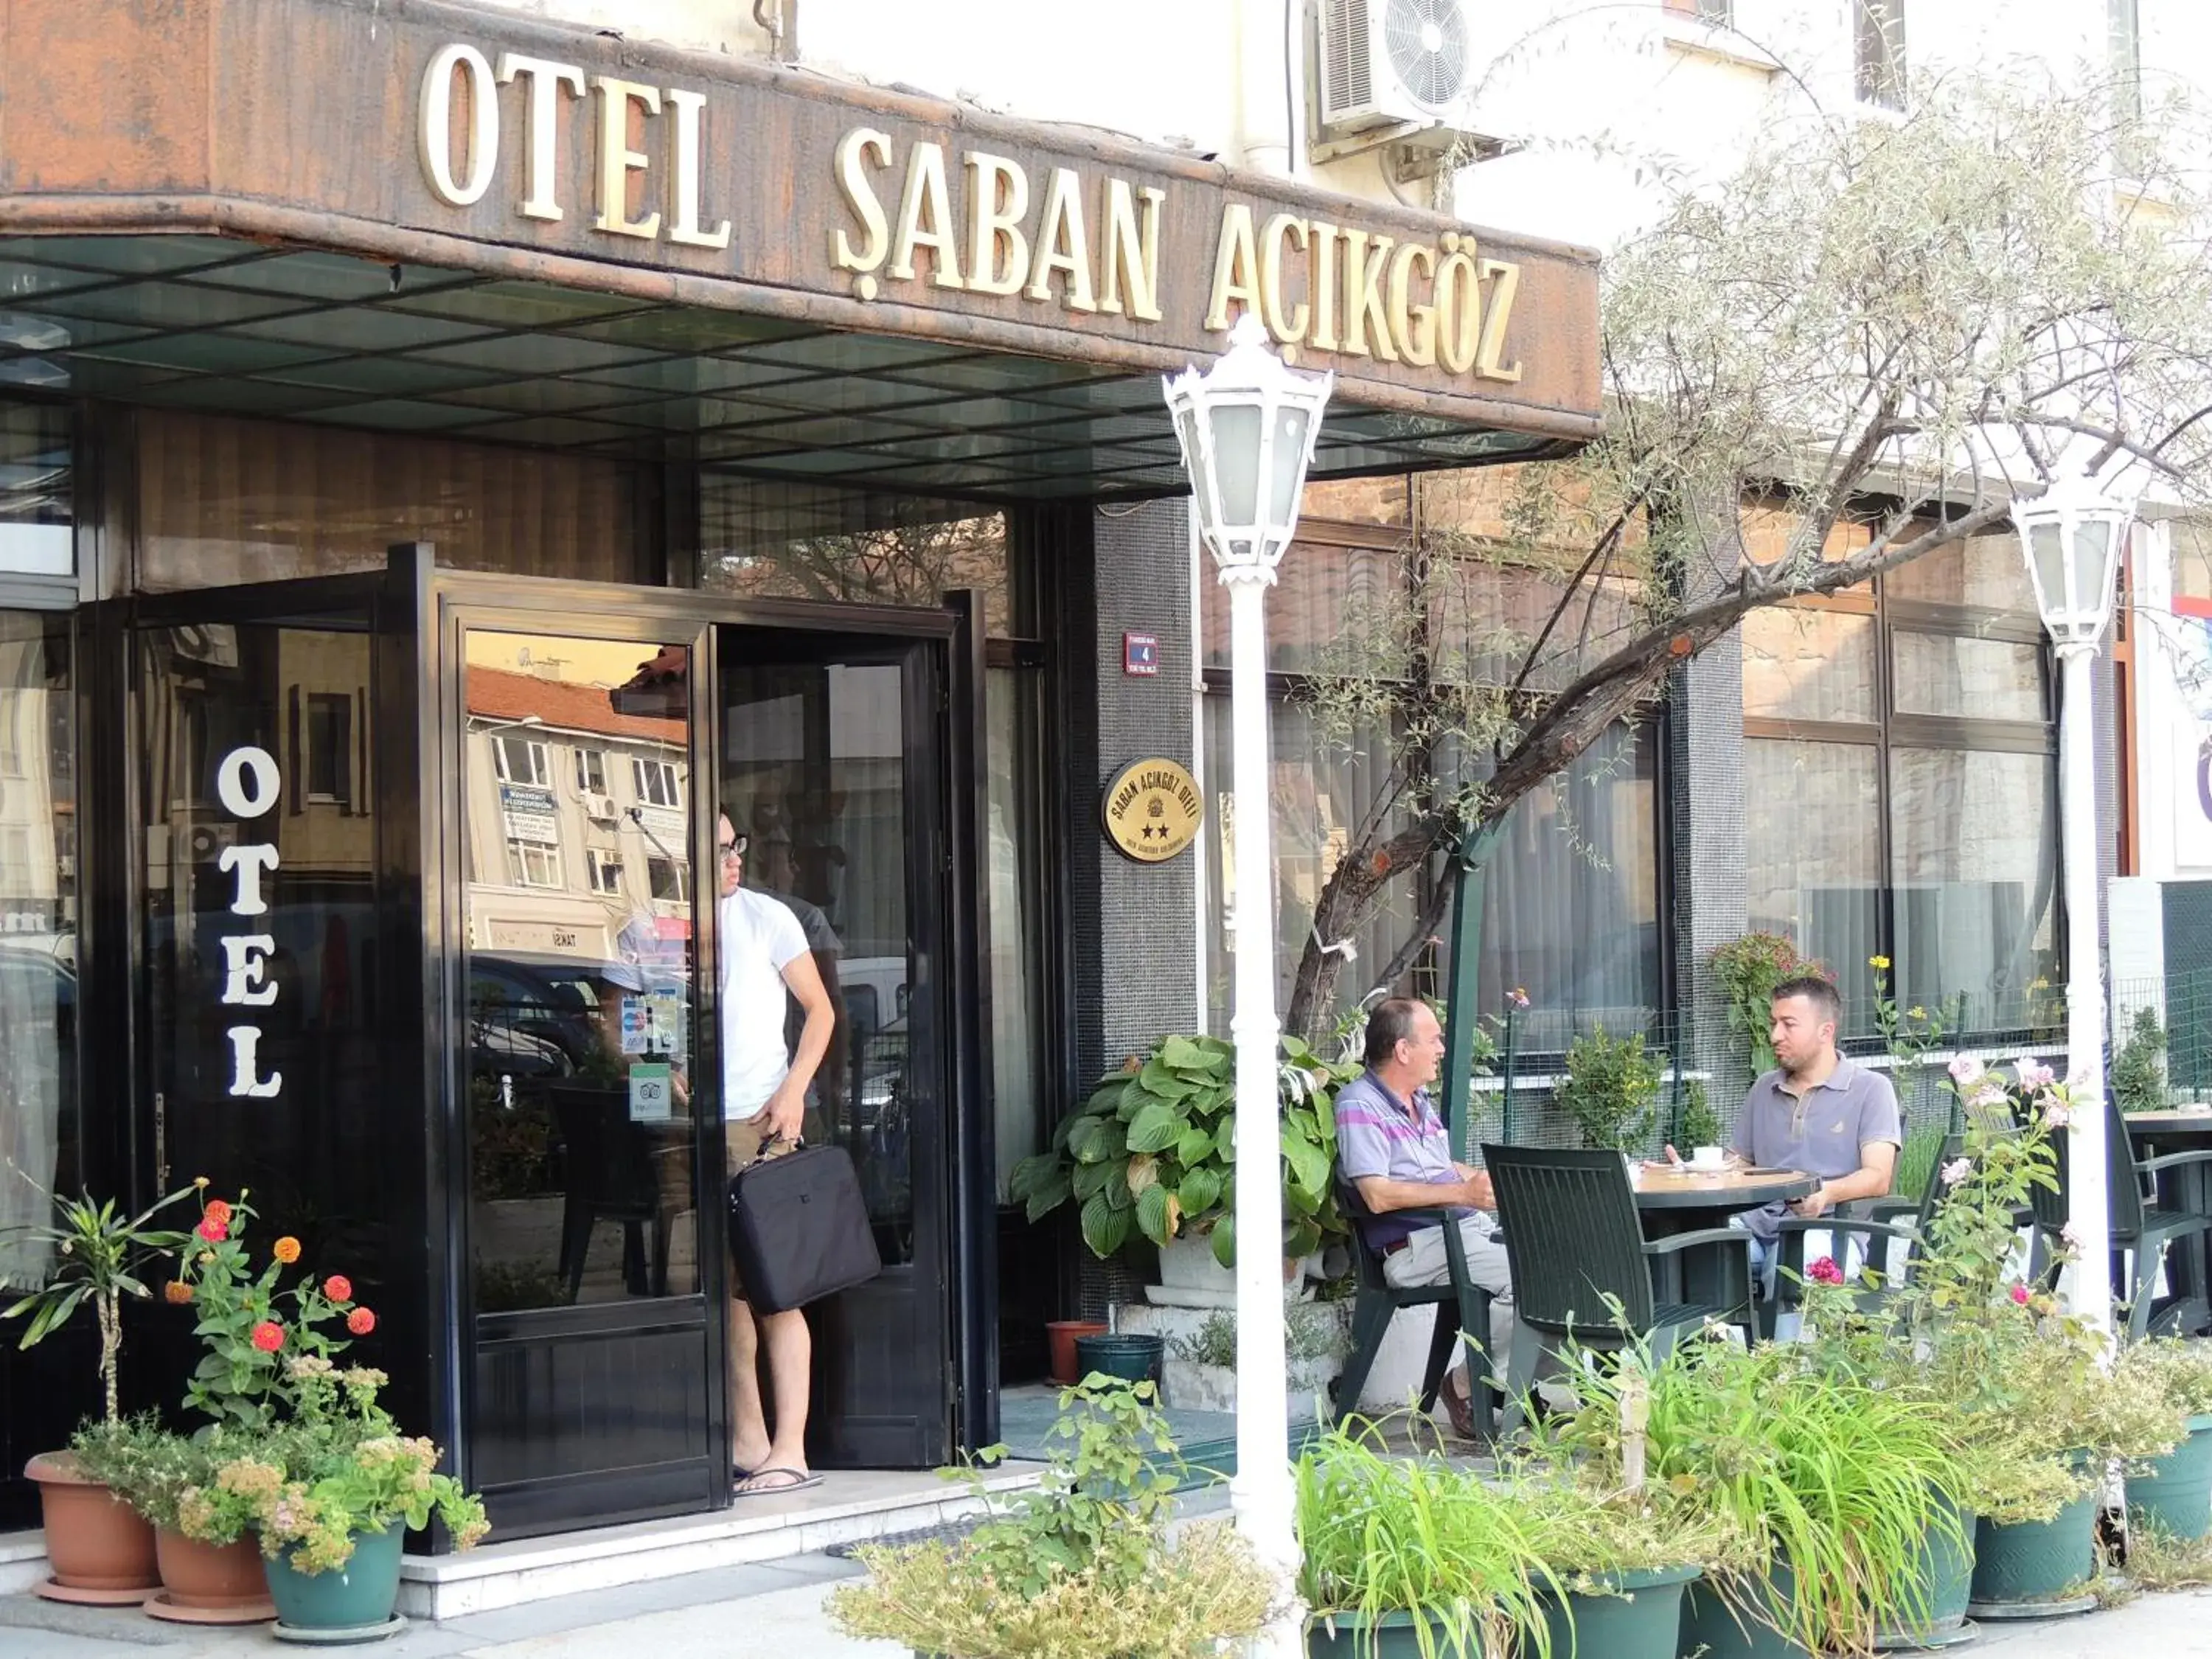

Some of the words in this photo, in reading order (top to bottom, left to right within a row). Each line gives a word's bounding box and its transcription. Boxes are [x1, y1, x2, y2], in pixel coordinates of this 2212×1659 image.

[417, 43, 732, 251] OTEL
[828, 126, 1166, 323] ŞABAN
[1203, 203, 1523, 383] AÇIKGÖZ
[1141, 647, 1150, 663] 4
[217, 745, 282, 1099] OTEL
